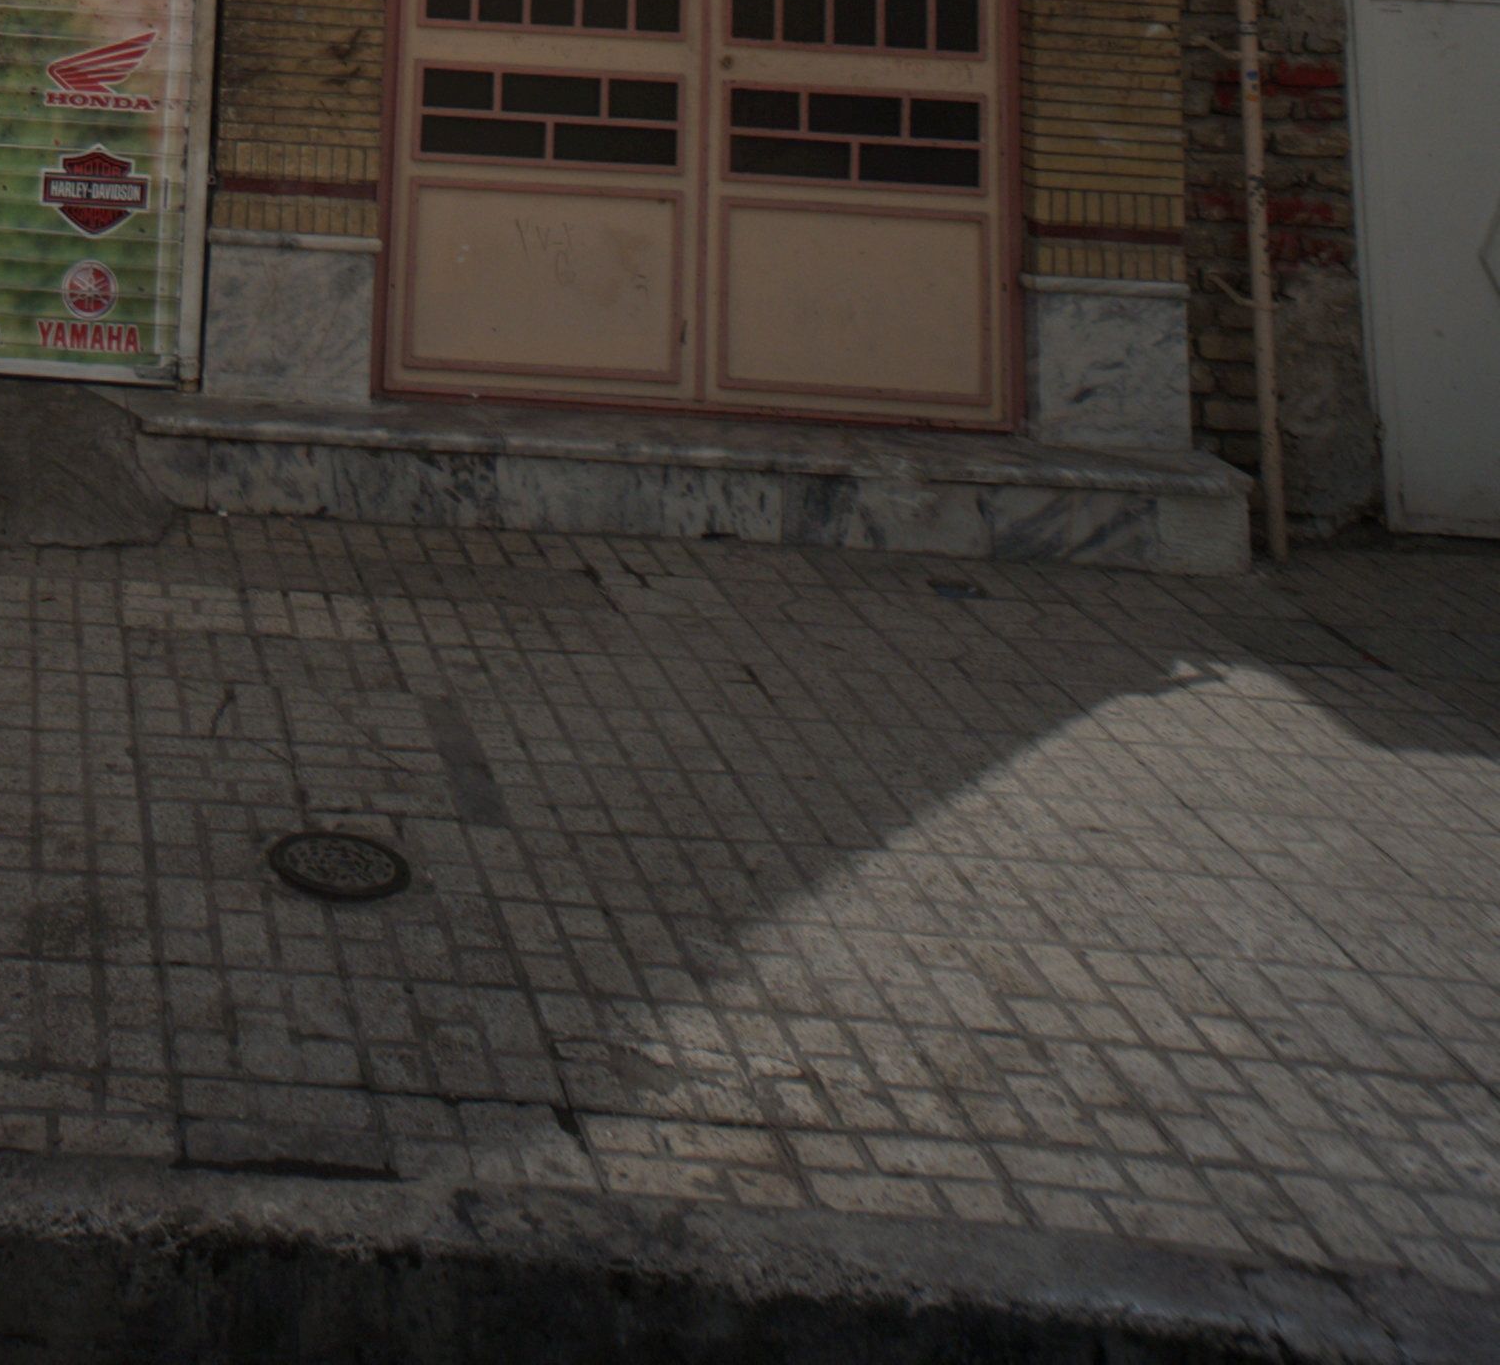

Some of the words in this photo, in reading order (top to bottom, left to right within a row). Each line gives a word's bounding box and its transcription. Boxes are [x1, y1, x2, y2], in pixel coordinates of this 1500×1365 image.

[45, 91, 155, 111] HONDA
[51, 179, 141, 201] HARLEY-DAVIDSON
[38, 320, 141, 353] YAMAHA
